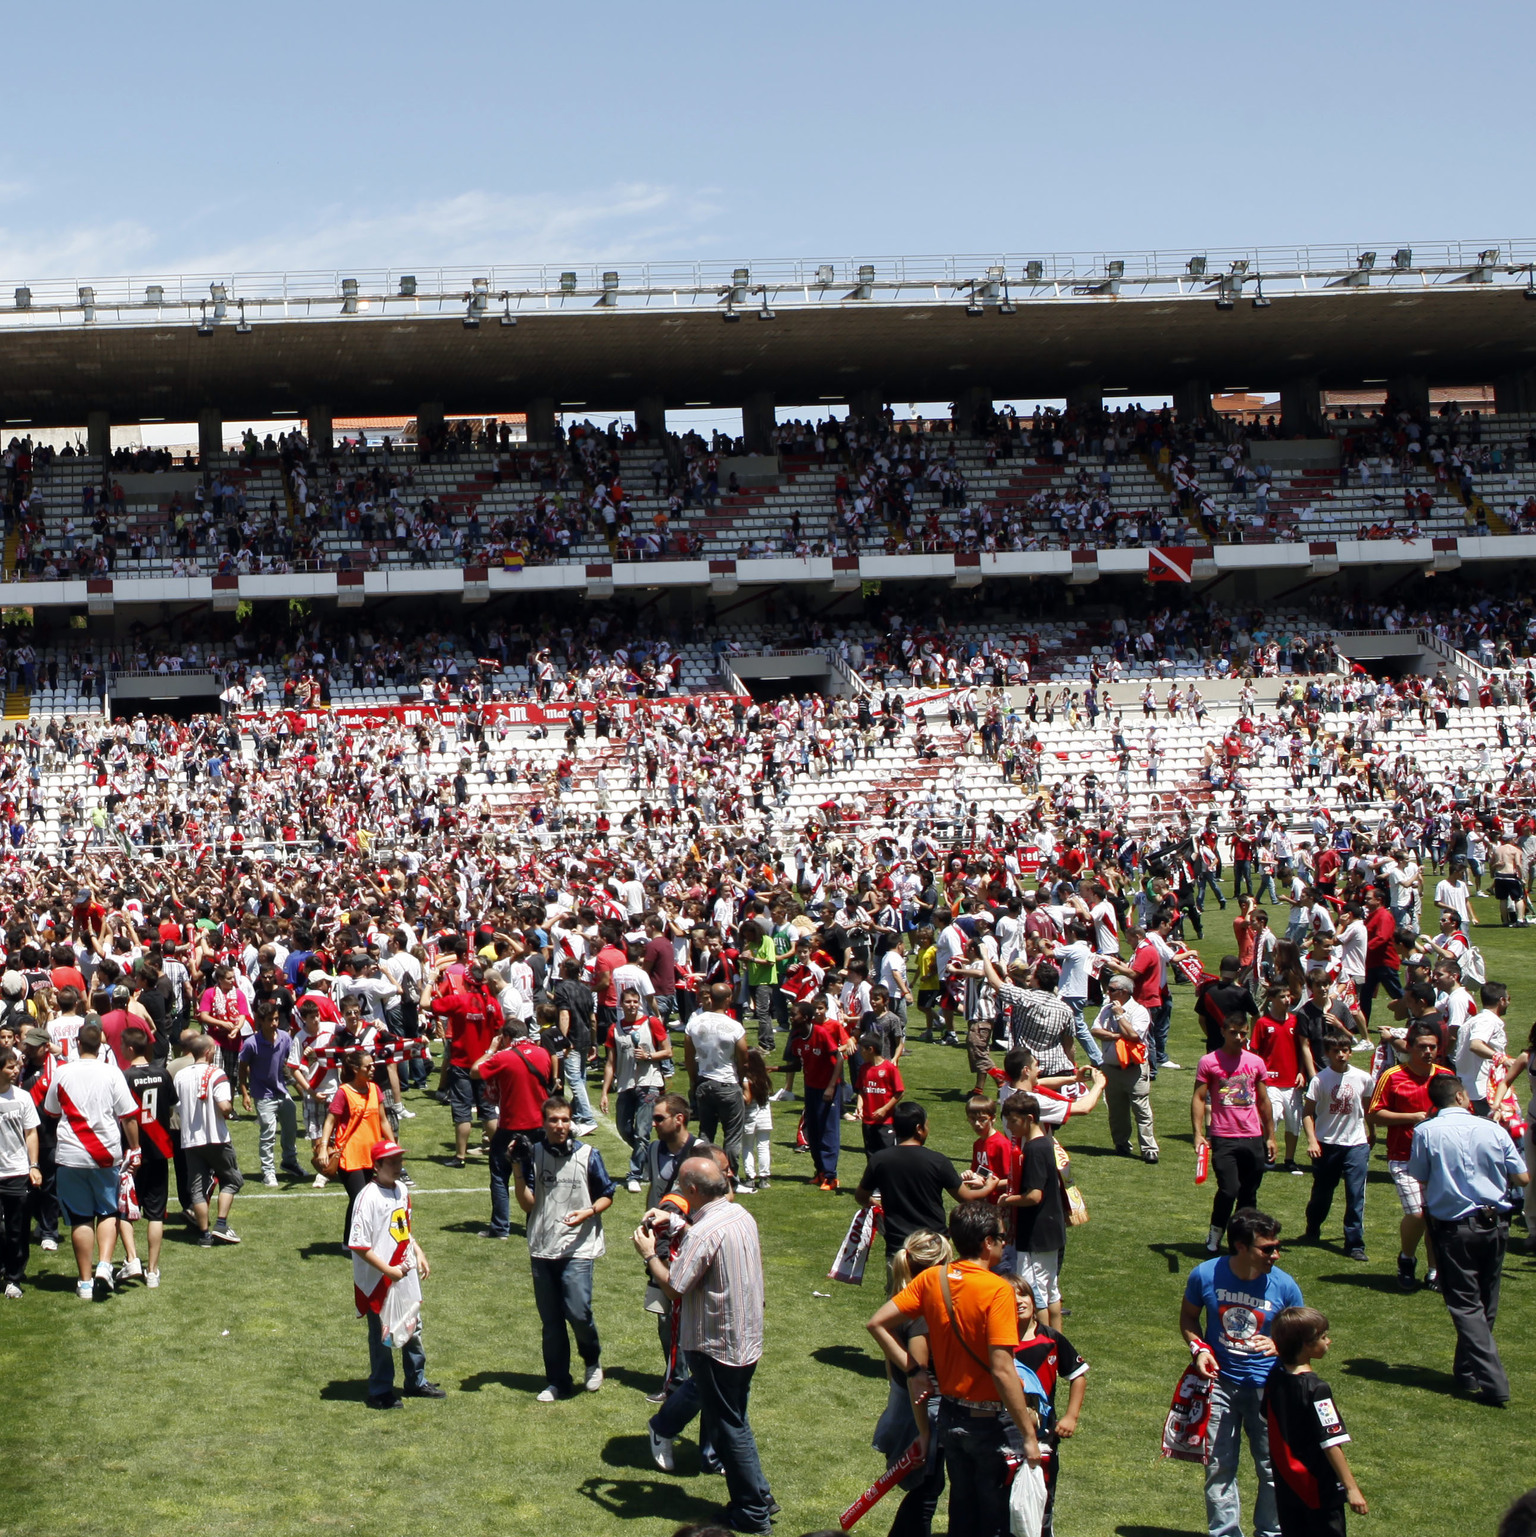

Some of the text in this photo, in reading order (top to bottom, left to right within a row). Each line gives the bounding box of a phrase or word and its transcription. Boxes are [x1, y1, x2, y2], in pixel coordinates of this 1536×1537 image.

[357, 993, 371, 1015] 2
[133, 1075, 163, 1087] pachon
[141, 1087, 158, 1124] 9
[1215, 1288, 1273, 1312] Fulton
